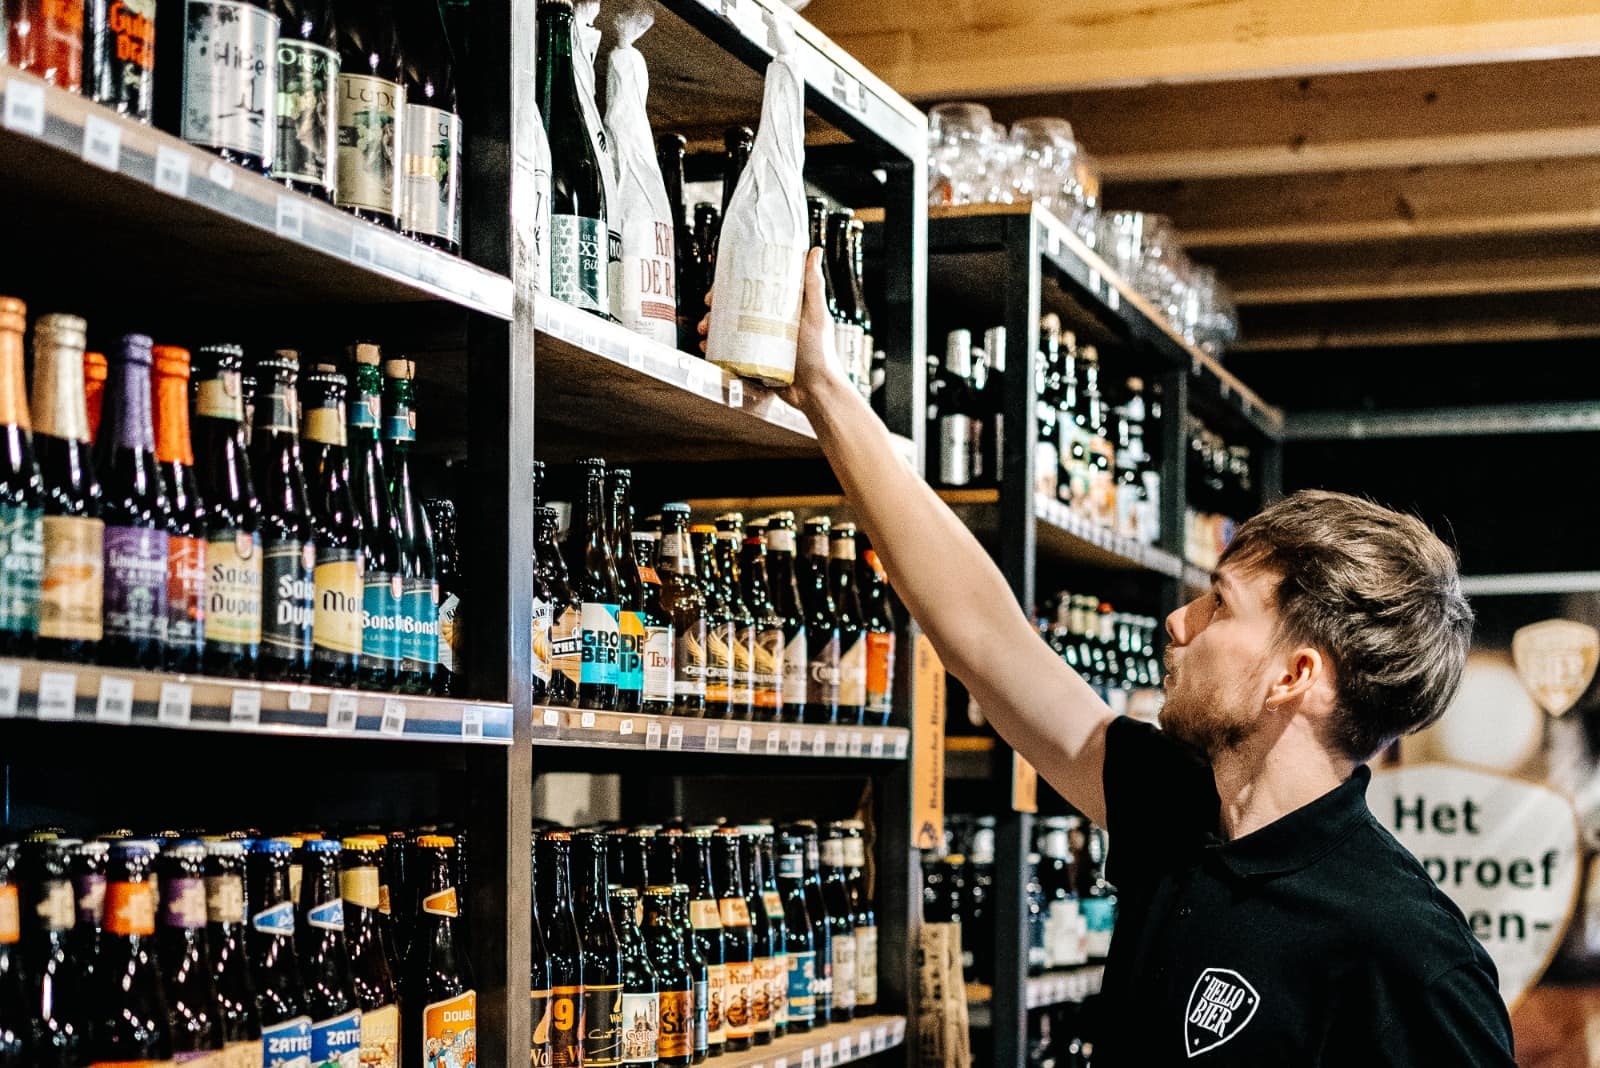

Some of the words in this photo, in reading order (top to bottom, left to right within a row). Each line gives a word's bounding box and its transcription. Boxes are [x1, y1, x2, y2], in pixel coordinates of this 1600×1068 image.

[582, 629, 619, 647] GRO
[1395, 796, 1480, 834] Het
[1203, 976, 1246, 1011] HELLO
[553, 998, 575, 1031] 9
[1189, 996, 1232, 1038] BIER
